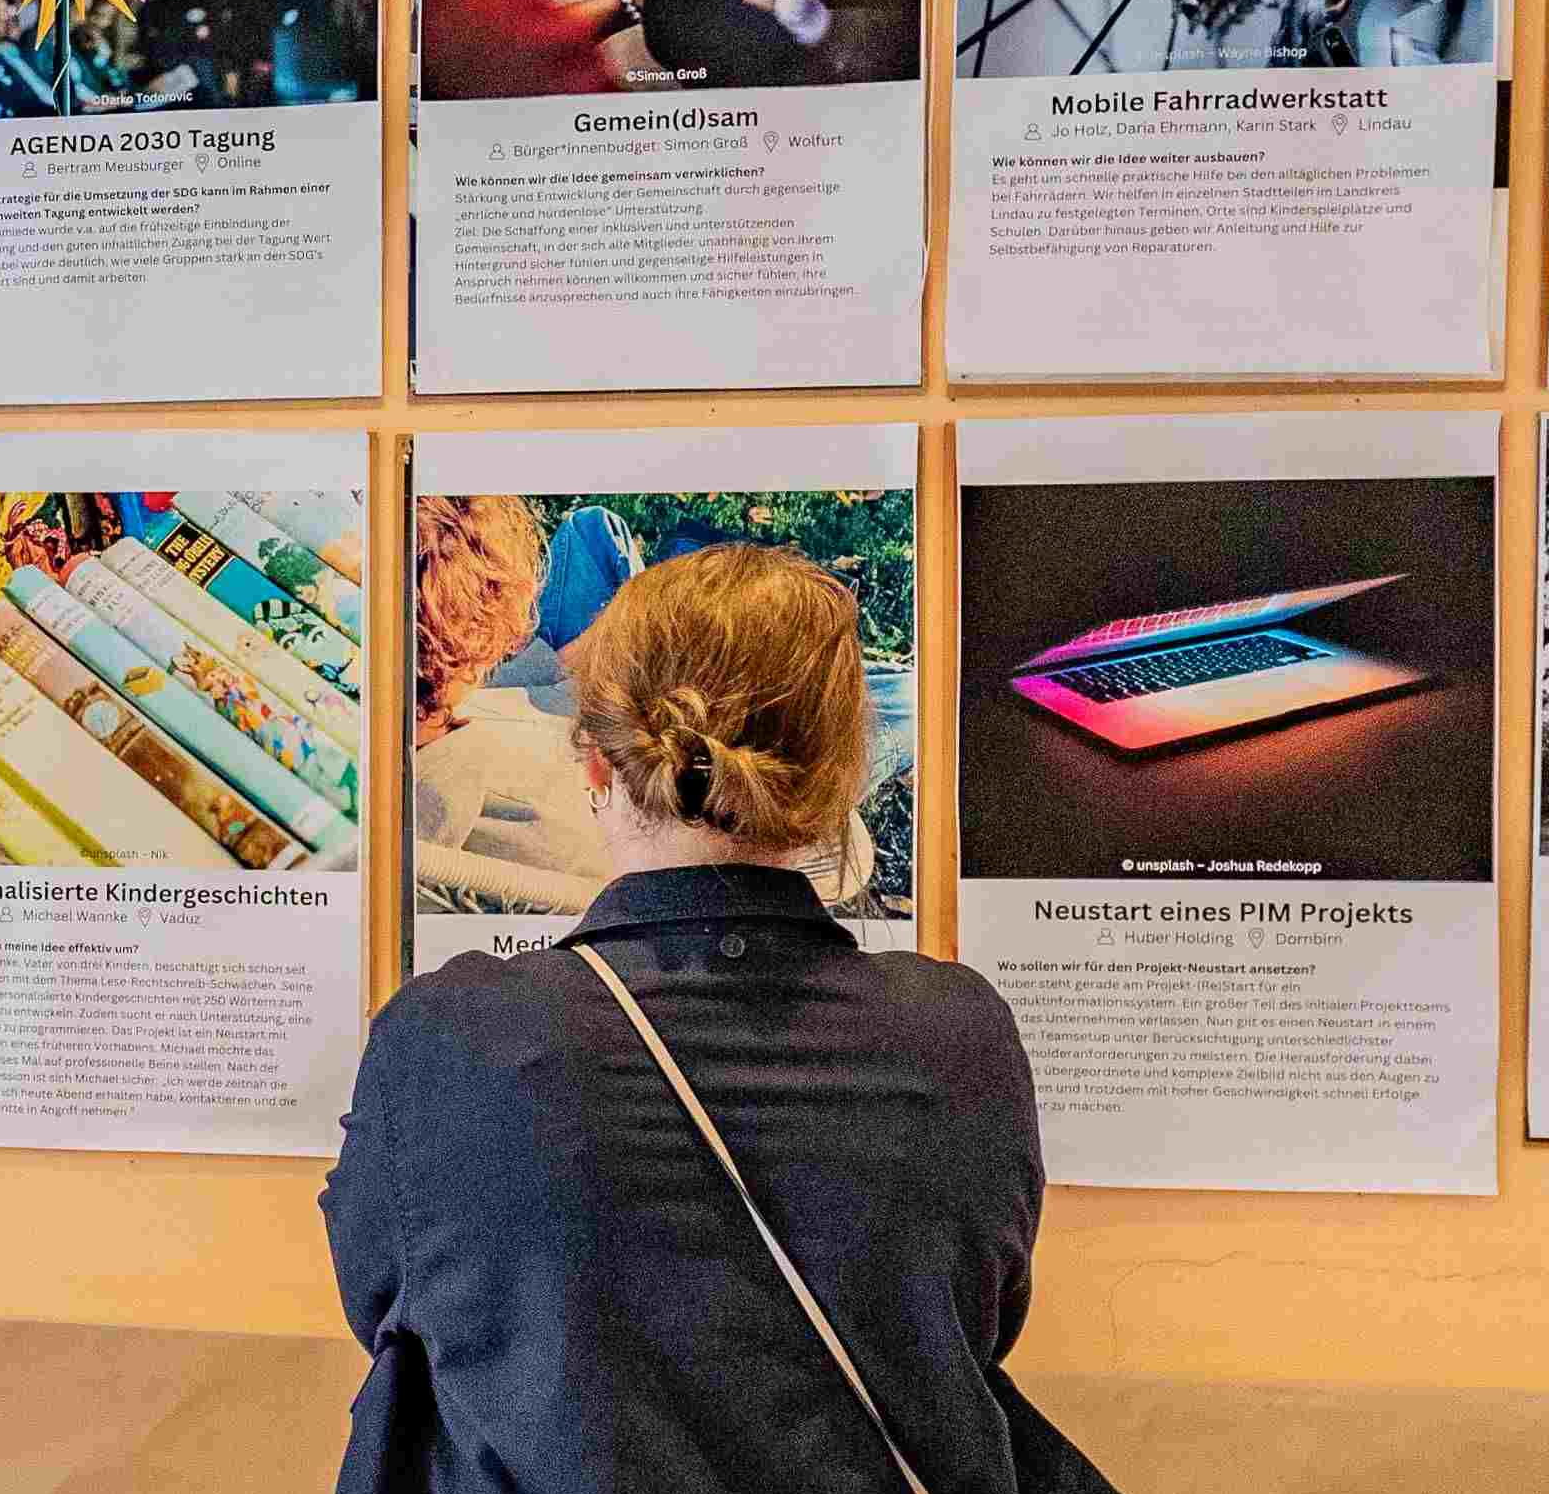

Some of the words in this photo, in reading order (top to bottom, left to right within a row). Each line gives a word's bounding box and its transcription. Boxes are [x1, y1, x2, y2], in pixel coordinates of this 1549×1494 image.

[1052, 91, 1144, 116] Mobile
[1153, 87, 1388, 112] Fahrradwerkstatt
[574, 107, 758, 133] Gemein(d)sam
[1050, 123, 1070, 139] Jo
[1074, 122, 1112, 138] Holz,
[1116, 122, 1156, 135] Daria
[1160, 120, 1231, 135] Ehrmann,
[1236, 119, 1274, 132] Karin
[1279, 118, 1317, 132] Stark
[1358, 117, 1412, 132] Lindau
[9, 133, 114, 156] AGENDA
[119, 130, 181, 152] 2030
[187, 129, 276, 153] Tagung
[663, 138, 710, 152] Simon
[788, 133, 843, 148] Wolfurt
[47, 162, 101, 175] Bertram
[105, 159, 184, 174] Meusburger
[217, 155, 262, 169] Online
[43, 191, 61, 202] für
[62, 190, 81, 202] die
[83, 190, 149, 202] Umsetzung
[150, 188, 171, 199] der
[172, 186, 198, 198] SDG
[201, 186, 230, 196] kann
[232, 186, 247, 196] im
[249, 185, 298, 196] Rahmen
[300, 182, 331, 194] einer
[44, 208, 86, 221] Tagung
[88, 204, 148, 218] entwickelt
[150, 203, 201, 215] werden?
[1136, 858, 1195, 874] unsplash
[1207, 859, 1254, 872] Joshua
[1255, 859, 1323, 875] Redekopp
[106, 882, 328, 909] Kindergeschichten
[22, 907, 73, 924] Michael
[76, 910, 128, 924] Wannke
[159, 912, 201, 925] Vaduz
[1035, 900, 1153, 922] Neustart
[1160, 900, 1231, 922] eines
[1240, 902, 1290, 923] PIM
[1300, 901, 1413, 929] Projekts
[1124, 930, 1171, 945] Huber
[1175, 930, 1235, 948] Holding
[1275, 931, 1343, 947] Dornbirn
[996, 961, 1018, 972] Wo
[1020, 960, 1059, 972] sollen
[1061, 961, 1081, 972] wir
[1084, 960, 1104, 972] für
[1107, 962, 1133, 972] den
[1135, 962, 1247, 977] Projekt-Neustart
[1248, 964, 1316, 975] ansetzen?
